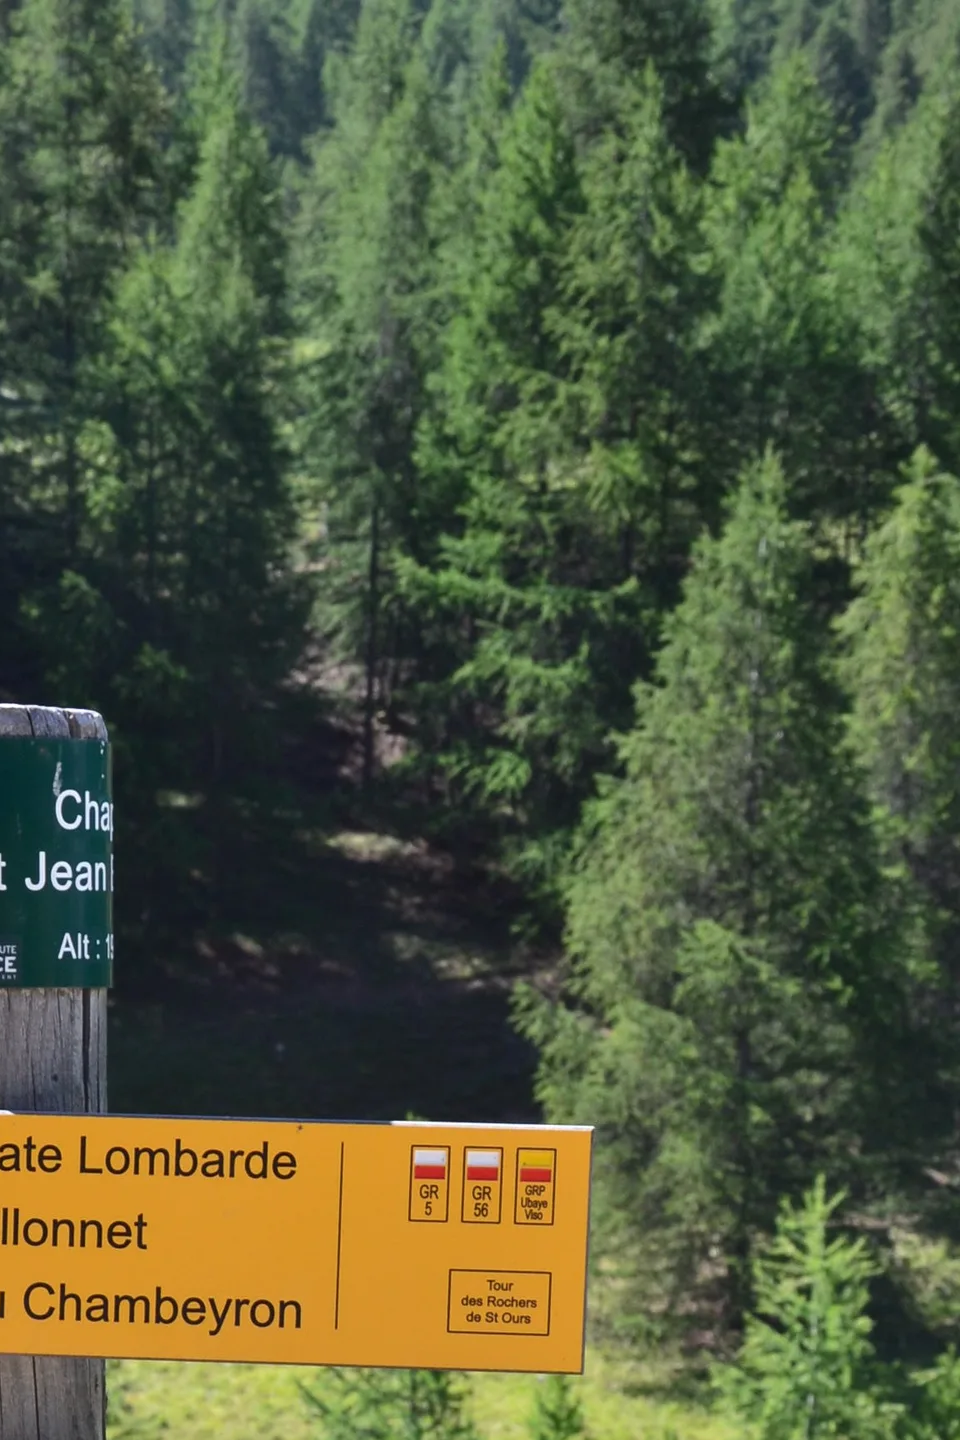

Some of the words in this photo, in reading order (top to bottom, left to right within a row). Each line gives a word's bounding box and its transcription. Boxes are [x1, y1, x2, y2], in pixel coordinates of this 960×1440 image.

[57, 932, 90, 960] Alt
[79, 1135, 297, 1180] Lombarde
[419, 1183, 439, 1200] GR
[471, 1185, 492, 1201] GR
[524, 1184, 546, 1197] GRP
[424, 1201, 433, 1217] 5
[473, 1202, 489, 1218] 56
[520, 1198, 549, 1211] Ubaye
[524, 1209, 544, 1221] Viso
[486, 1279, 514, 1292] Tour
[23, 1281, 302, 1336] Chambeyron
[460, 1294, 484, 1307] des
[486, 1295, 538, 1309] Rochers
[465, 1311, 482, 1323] de
[484, 1311, 499, 1324] St
[501, 1311, 532, 1325] Ours
